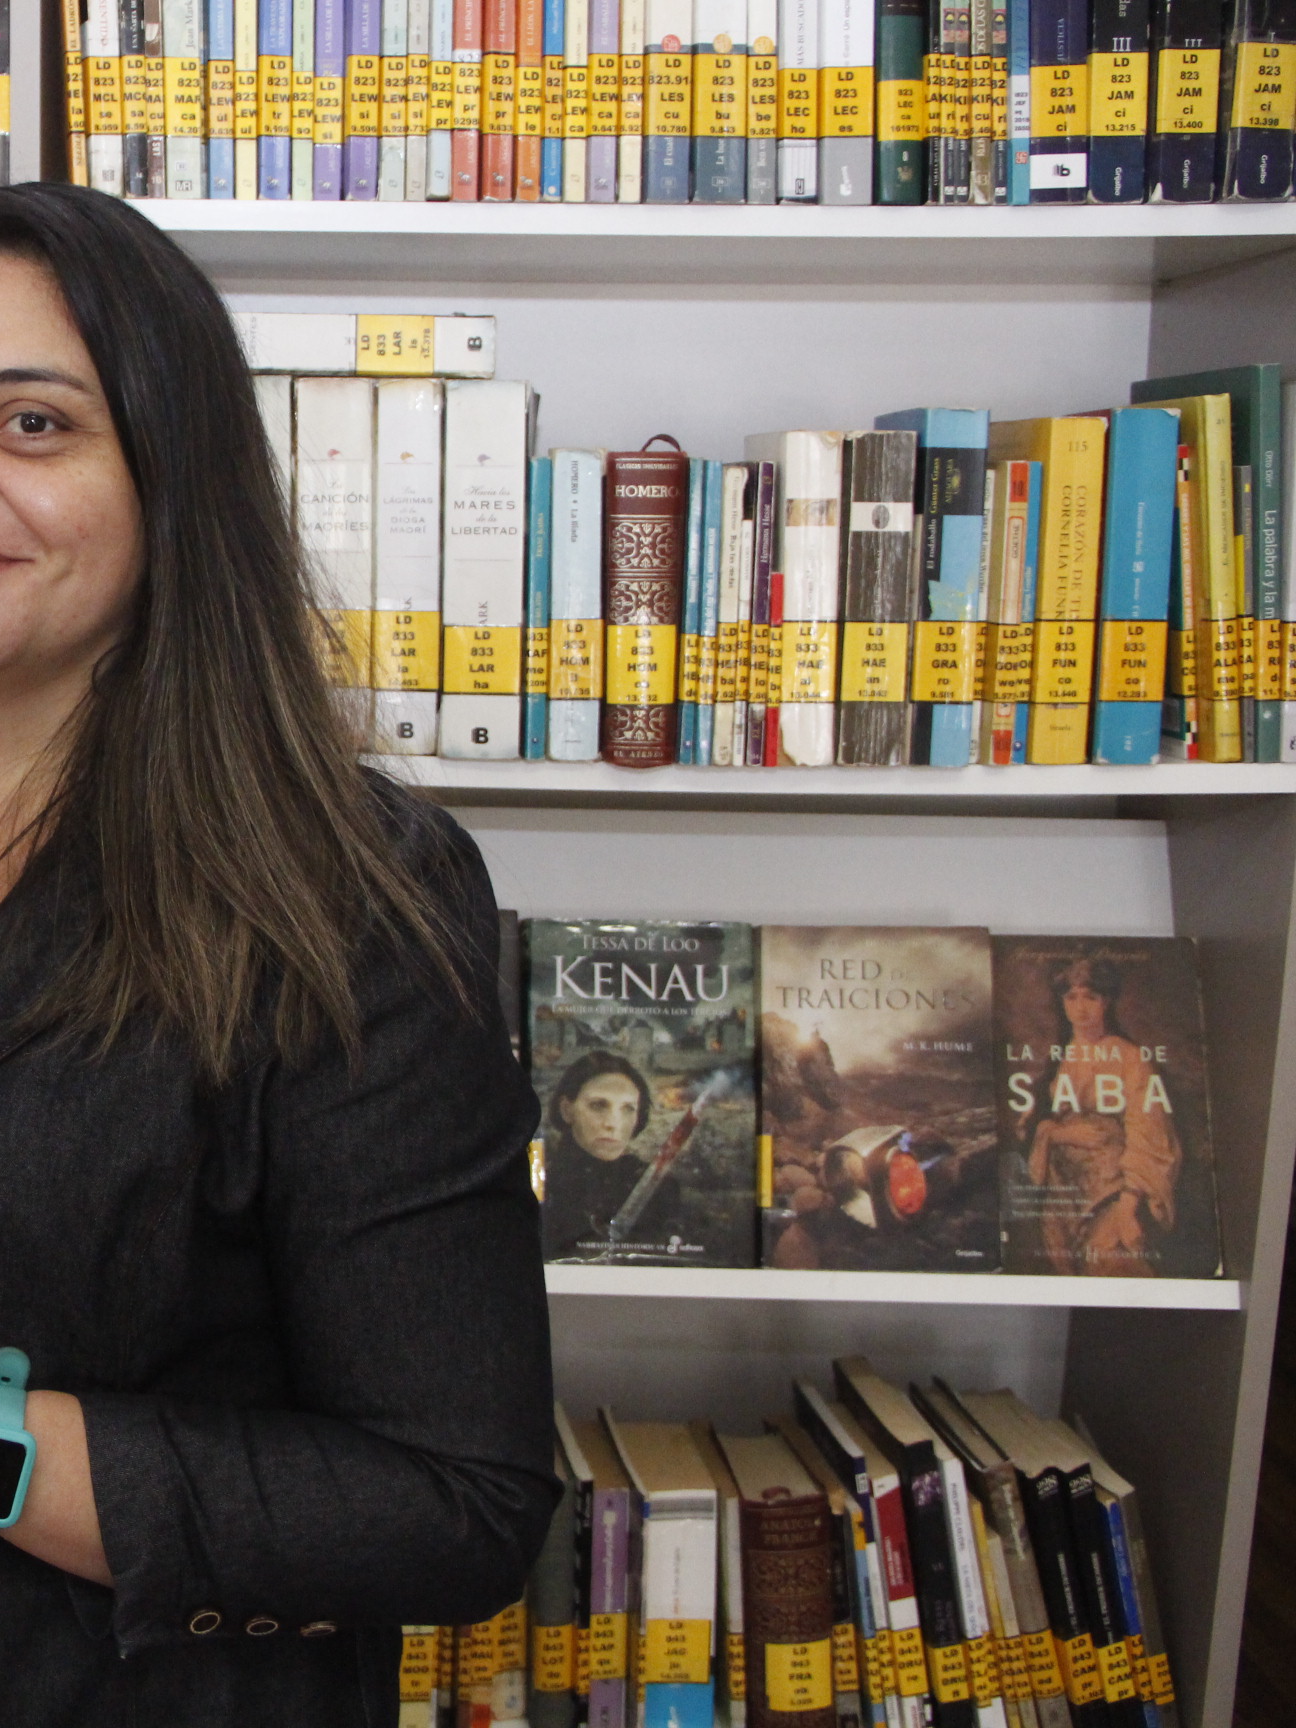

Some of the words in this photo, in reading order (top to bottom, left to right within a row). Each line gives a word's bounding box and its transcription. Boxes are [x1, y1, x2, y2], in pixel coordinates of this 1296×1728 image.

[1057, 18, 1067, 62] JUSTICIA
[1112, 38, 1131, 52] III
[1185, 39, 1202, 47] III
[1263, 48, 1279, 58] LD
[96, 62, 110, 70] LD
[358, 60, 373, 68] LD
[1114, 58, 1129, 67] LD
[1259, 66, 1280, 76] 823
[354, 77, 376, 86] 823
[791, 73, 806, 82] LD
[838, 72, 854, 81] LD
[1111, 75, 1131, 83] 823
[835, 89, 857, 98] 823
[1177, 88, 1202, 97] JAM
[1254, 84, 1281, 93] JAM
[93, 94, 117, 102] MCL
[351, 93, 378, 102] LEW
[787, 90, 809, 99] 823
[1108, 90, 1134, 100] JAM
[786, 107, 810, 116] LEC
[834, 106, 858, 115] LEC
[1260, 102, 1271, 111] ci
[359, 111, 369, 119] si
[1115, 108, 1126, 117] ci
[1173, 121, 1202, 129] 13.400
[1249, 117, 1279, 126] 13.398
[791, 125, 805, 133] ho
[1105, 124, 1135, 132] 13.215
[1182, 159, 1190, 188] Grijalbo
[1260, 155, 1268, 184] Grijalbo
[1114, 167, 1122, 196] Grijalbo
[361, 330, 370, 350] LD
[377, 334, 385, 356] 833
[393, 330, 401, 355] LAR
[467, 336, 482, 350] B
[1068, 441, 1088, 452] 115
[931, 458, 939, 481] Grass
[616, 485, 680, 498] HOMERO
[301, 492, 369, 504] CANCIÓN
[453, 500, 516, 510] MARES
[762, 504, 770, 526] Hesse
[1265, 510, 1277, 524] La
[1058, 485, 1072, 569] CORNELIA
[1073, 486, 1087, 563] CORAZÓN
[451, 526, 517, 536] LIBERTAD
[928, 519, 936, 558] rodaballo
[760, 528, 769, 563] Hermann
[1262, 529, 1277, 576] palabra
[1072, 570, 1083, 588] DE
[1264, 592, 1277, 603] la
[474, 631, 490, 640] LD
[939, 626, 954, 636] LD
[1059, 626, 1074, 635] LD
[471, 648, 493, 657] 833
[935, 643, 956, 652] 833
[469, 663, 494, 673] LAR
[932, 659, 957, 668] GRA
[1053, 659, 1077, 668] FUN
[398, 723, 413, 739] B
[473, 728, 488, 744] B
[580, 932, 628, 951] TESSA
[635, 937, 655, 951] DE
[662, 936, 699, 952] LOO
[820, 958, 883, 981] RED
[550, 955, 733, 1005] KENAU
[777, 985, 975, 1011] TRAICIONES
[933, 1042, 972, 1052] HUME
[1007, 1044, 1033, 1061] LA
[1051, 1045, 1122, 1062] REINA
[1141, 1046, 1166, 1063] DE
[1008, 1072, 1172, 1113] SABA
[1072, 1638, 1086, 1649] LD
